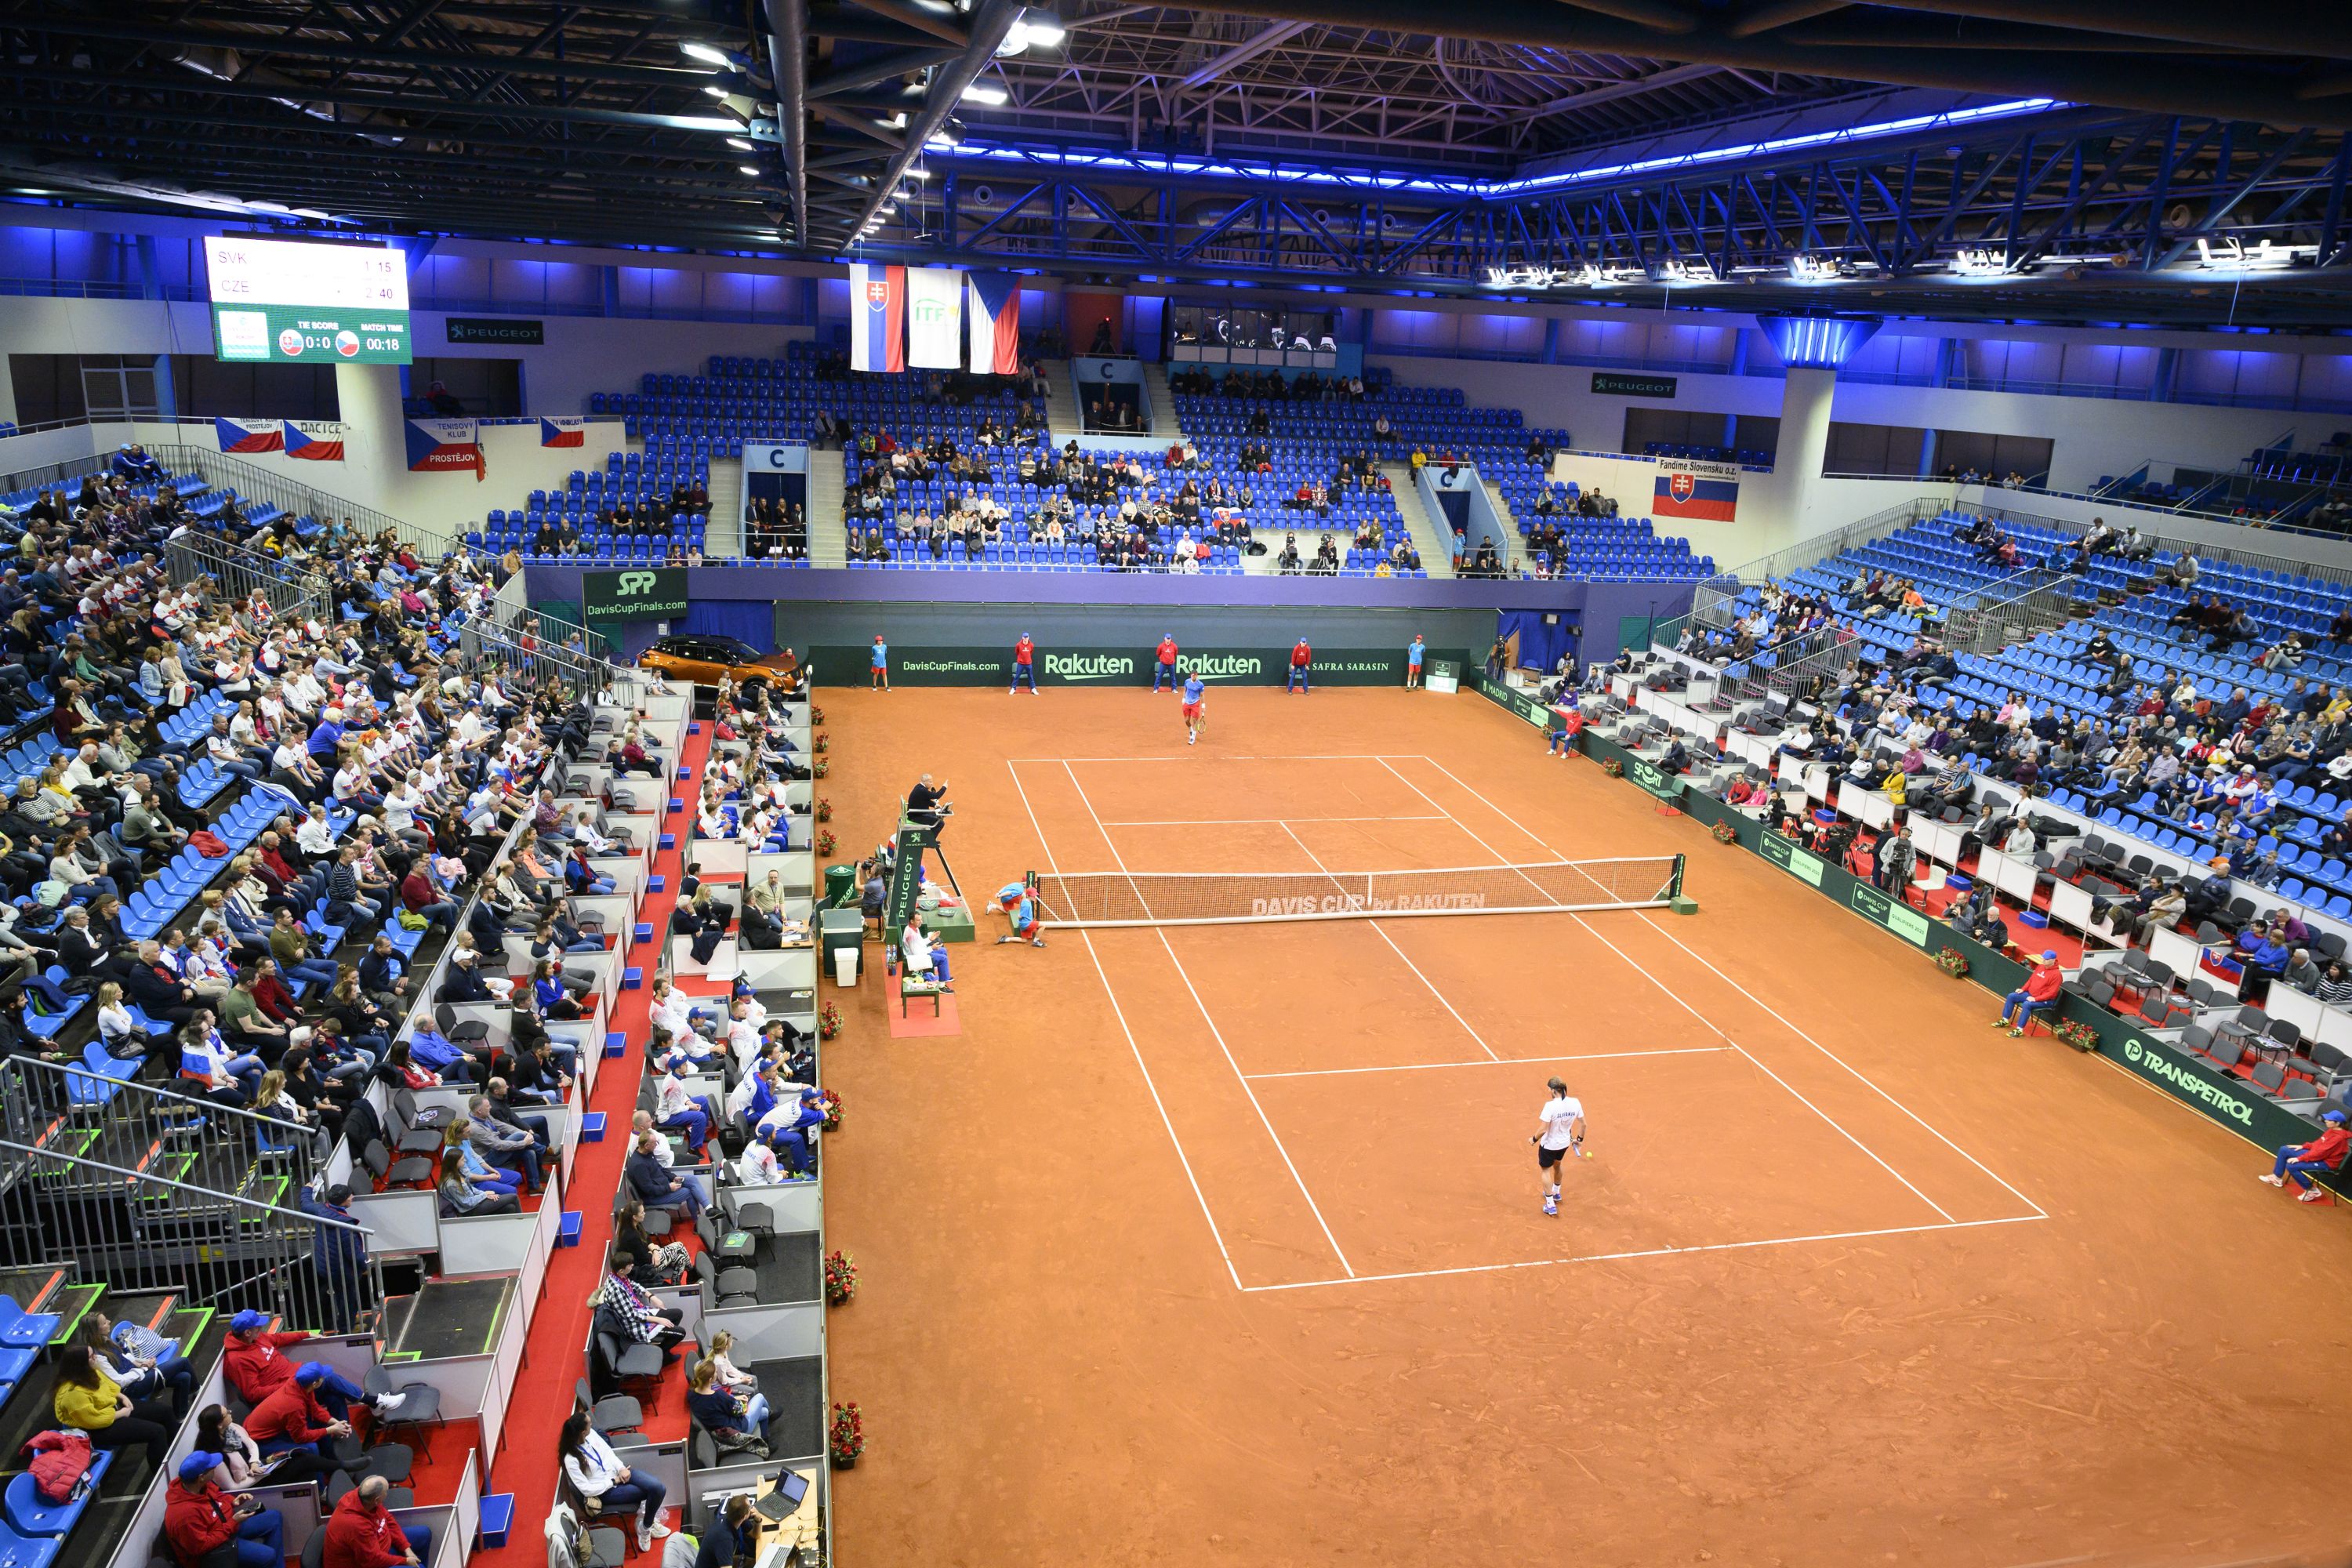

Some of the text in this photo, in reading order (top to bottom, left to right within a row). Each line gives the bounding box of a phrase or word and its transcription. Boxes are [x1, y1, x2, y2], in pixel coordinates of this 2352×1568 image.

[218, 251, 247, 264] SVK
[378, 262, 391, 273] 15
[221, 280, 249, 292] CZE
[379, 289, 393, 299] 40
[916, 307, 945, 321] ITF
[297, 321, 339, 331] TIE SCORE
[361, 323, 404, 332] MATCH TIME
[467, 328, 539, 338] PEUGEOT
[366, 338, 400, 350] 00:18
[1101, 362, 1113, 379] C
[1609, 382, 1673, 393] PEUGEOT
[770, 449, 784, 468] C
[1690, 461, 1724, 474] Slovensku
[1440, 470, 1453, 488] C
[617, 572, 657, 596] SPP
[587, 601, 687, 615] DavisCupFinals.com
[903, 661, 1000, 673] DavisCupFinals.com
[1045, 654, 1134, 674] Rakuten
[1177, 654, 1261, 674] Rakuten
[1312, 662, 1389, 671] SAFRA SARASIN
[1489, 684, 1508, 702] MADRID
[1634, 761, 1663, 788] SPORT
[898, 854, 913, 918] PEUGEOT
[1252, 893, 1486, 916] DAVIS CUP by RAKUTEN
[1863, 895, 1888, 911] DAVIS CUP
[2143, 1051, 2253, 1126] TRANSPETROL
